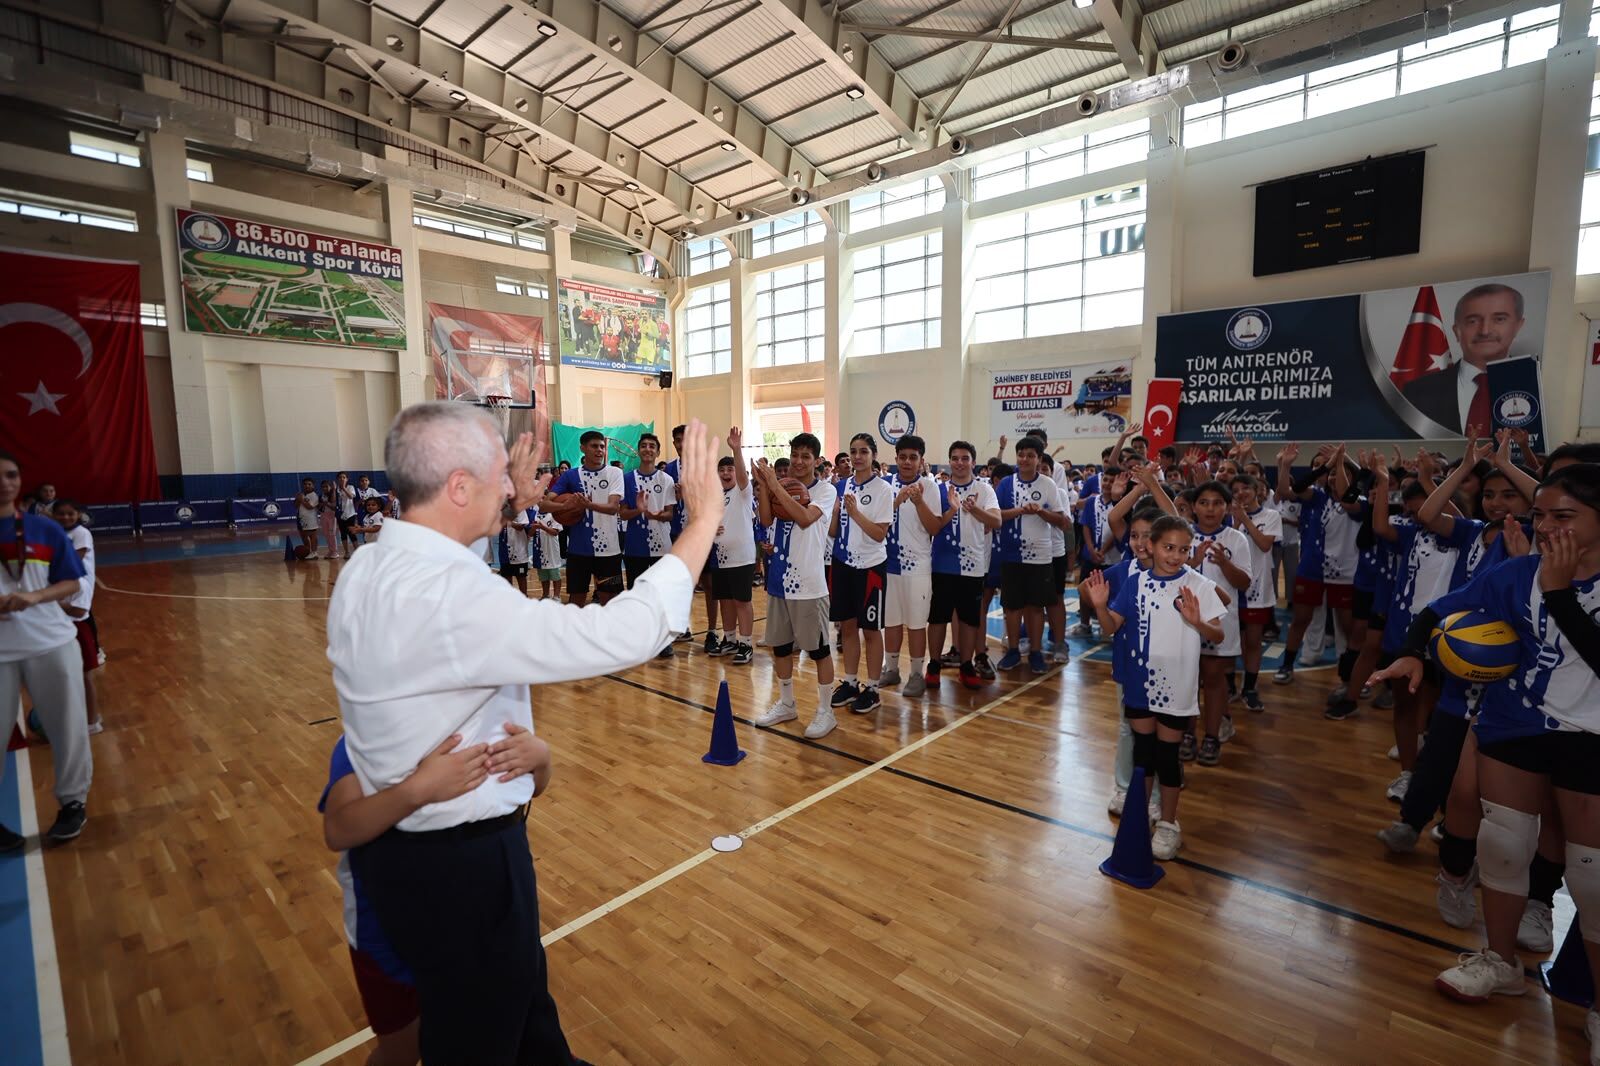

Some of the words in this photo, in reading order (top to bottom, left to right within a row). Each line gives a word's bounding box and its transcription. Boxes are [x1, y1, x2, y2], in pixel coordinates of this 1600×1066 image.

[235, 221, 310, 249] 86.500
[340, 241, 402, 265] alanda
[236, 239, 306, 264] Akkent
[312, 252, 355, 271] Spor
[360, 259, 402, 279] Köyü
[1186, 356, 1217, 372] TÜM
[1222, 348, 1313, 370] ANTRENÖR
[994, 374, 1029, 384] ŞAHİNBEY
[1030, 369, 1072, 381] BELEDİYESİ
[1189, 366, 1333, 388] SPORCULARIMIZA
[995, 386, 1029, 398] MASA
[1030, 382, 1070, 396] TENİSİ
[1180, 388, 1256, 406] AŞARILAR
[1261, 382, 1332, 401] DİLERİM
[1005, 399, 1059, 410] TURNUVASI
[1211, 408, 1282, 424] Mehmet
[866, 605, 876, 622] 6
